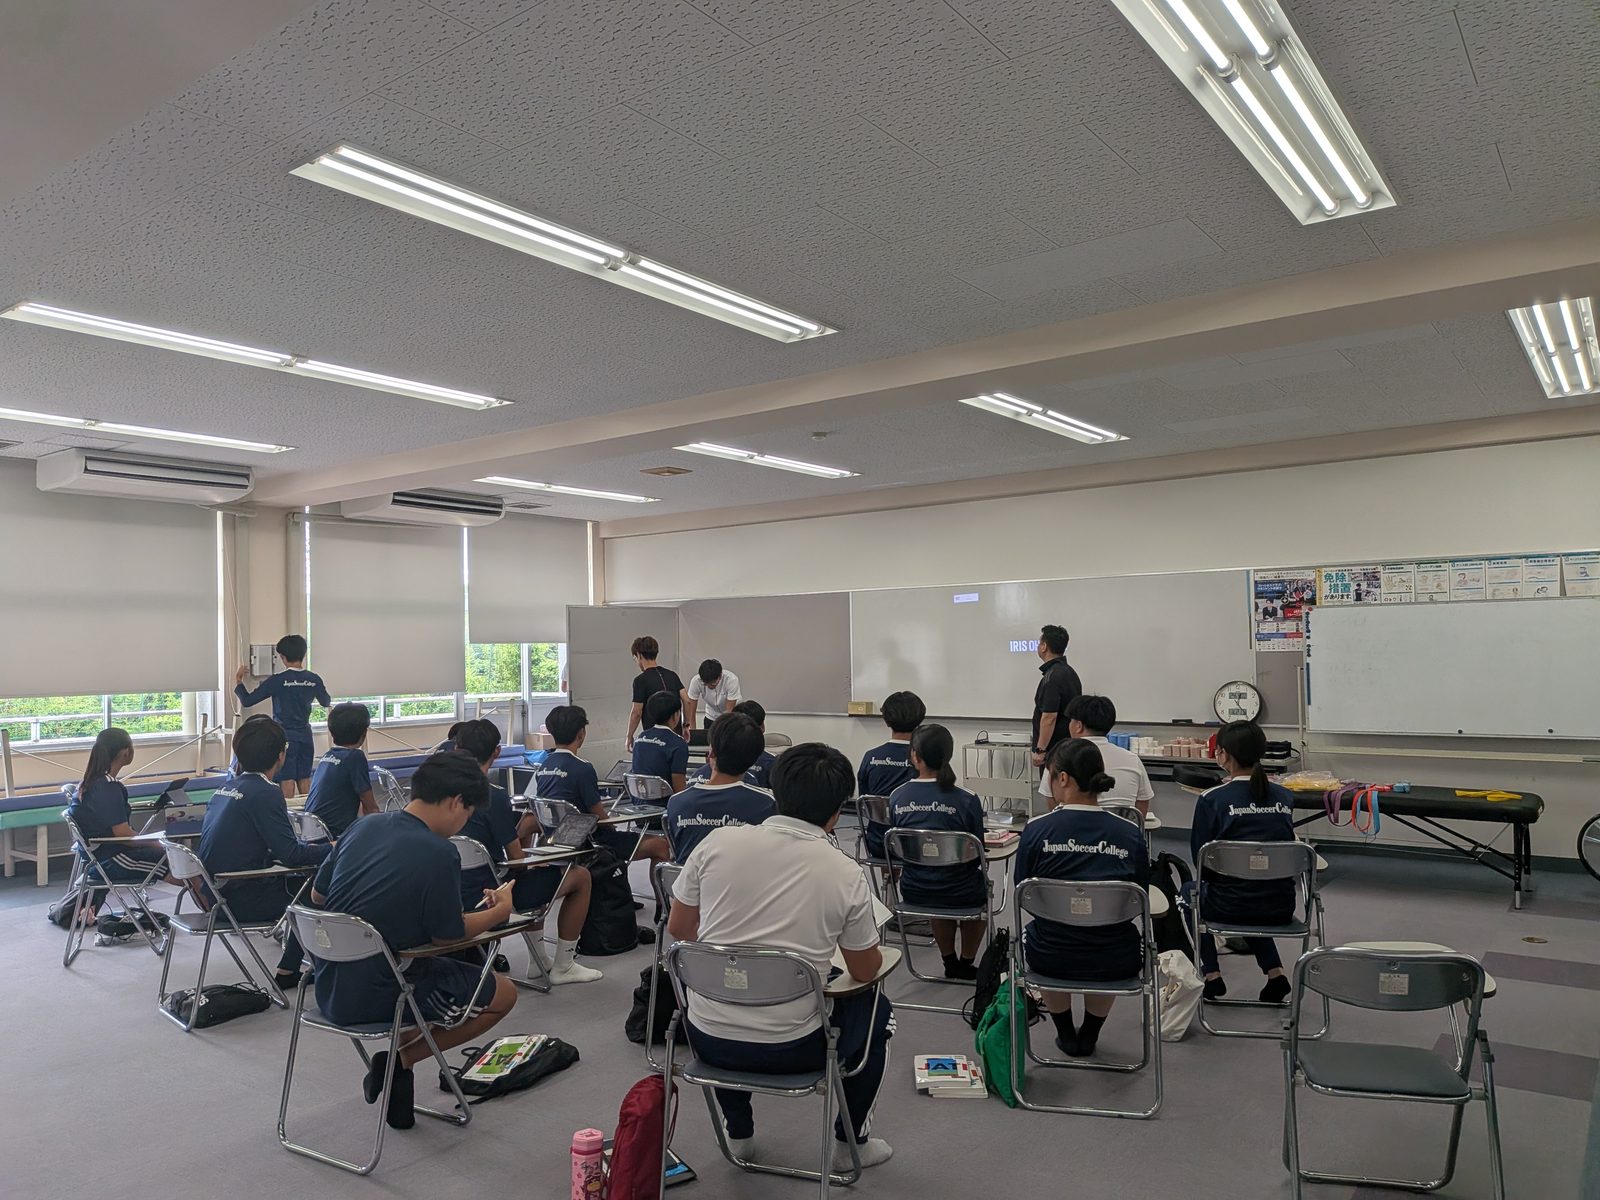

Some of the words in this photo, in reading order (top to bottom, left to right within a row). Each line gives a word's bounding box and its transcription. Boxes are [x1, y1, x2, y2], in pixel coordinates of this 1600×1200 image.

[1324, 572, 1347, 583] 免除
[1328, 583, 1352, 594] 措置
[1009, 640, 1028, 652] IRIS
[895, 801, 957, 815] JapanSoccerCollege
[1042, 838, 1129, 859] JapanSoccerCollege
